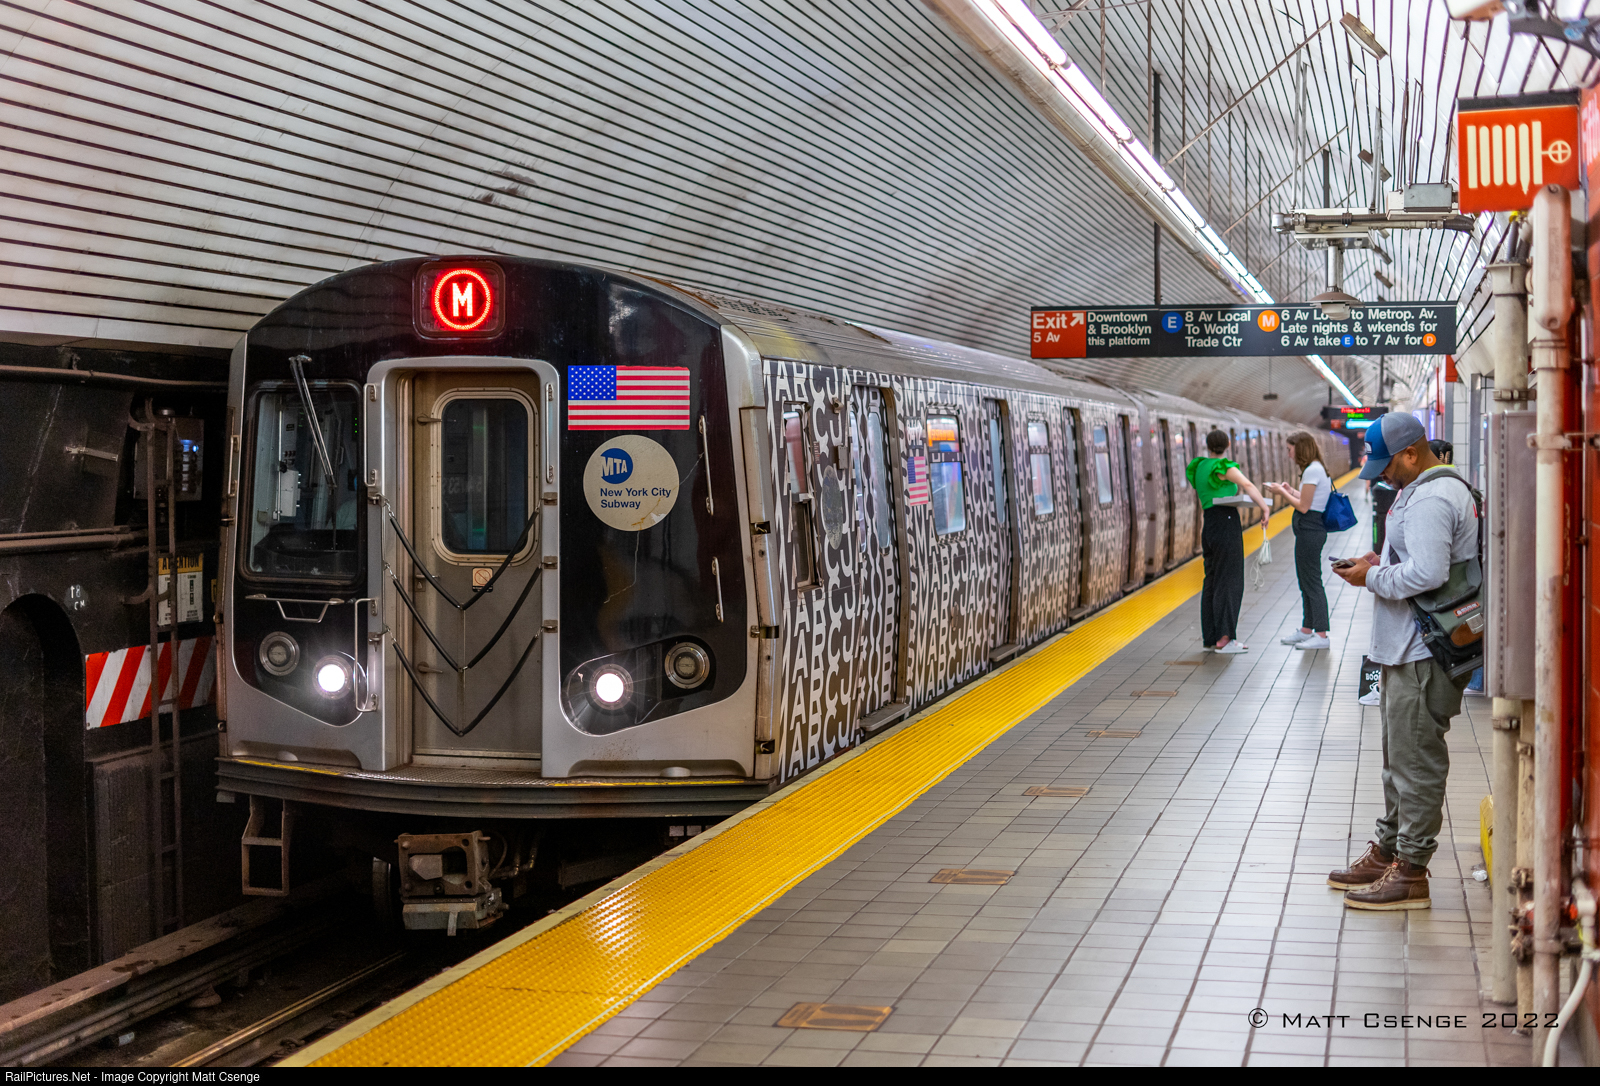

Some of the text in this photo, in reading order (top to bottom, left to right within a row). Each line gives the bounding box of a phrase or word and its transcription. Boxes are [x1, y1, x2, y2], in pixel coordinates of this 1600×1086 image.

[452, 282, 473, 317] M
[1032, 313, 1067, 329] Exit
[1087, 312, 1148, 323] Downtown
[1185, 310, 1251, 322] 8 Av Local
[1262, 314, 1275, 327] M
[1281, 310, 1290, 321] 6
[1294, 309, 1309, 321] Av
[1351, 309, 1364, 320] to
[1368, 308, 1415, 322] Metrop.
[1418, 308, 1437, 320] Av.
[1167, 316, 1177, 329] E
[1280, 321, 1438, 335] Late nights & wkends for
[1087, 324, 1152, 336] & Brooklyn
[1184, 323, 1239, 335] To World
[1033, 332, 1060, 343] 5 Av
[1087, 336, 1150, 347] this platform
[1184, 336, 1243, 347] Trade Ctr
[1280, 335, 1290, 346] 6
[1294, 335, 1309, 346] Av
[1313, 335, 1341, 346] take
[1355, 335, 1368, 346] to
[1372, 334, 1381, 345] 7
[1385, 334, 1400, 345] Av
[1404, 334, 1422, 345] for
[600, 455, 628, 478] MTA
[600, 487, 672, 499] New York City
[600, 499, 641, 510] Subway
